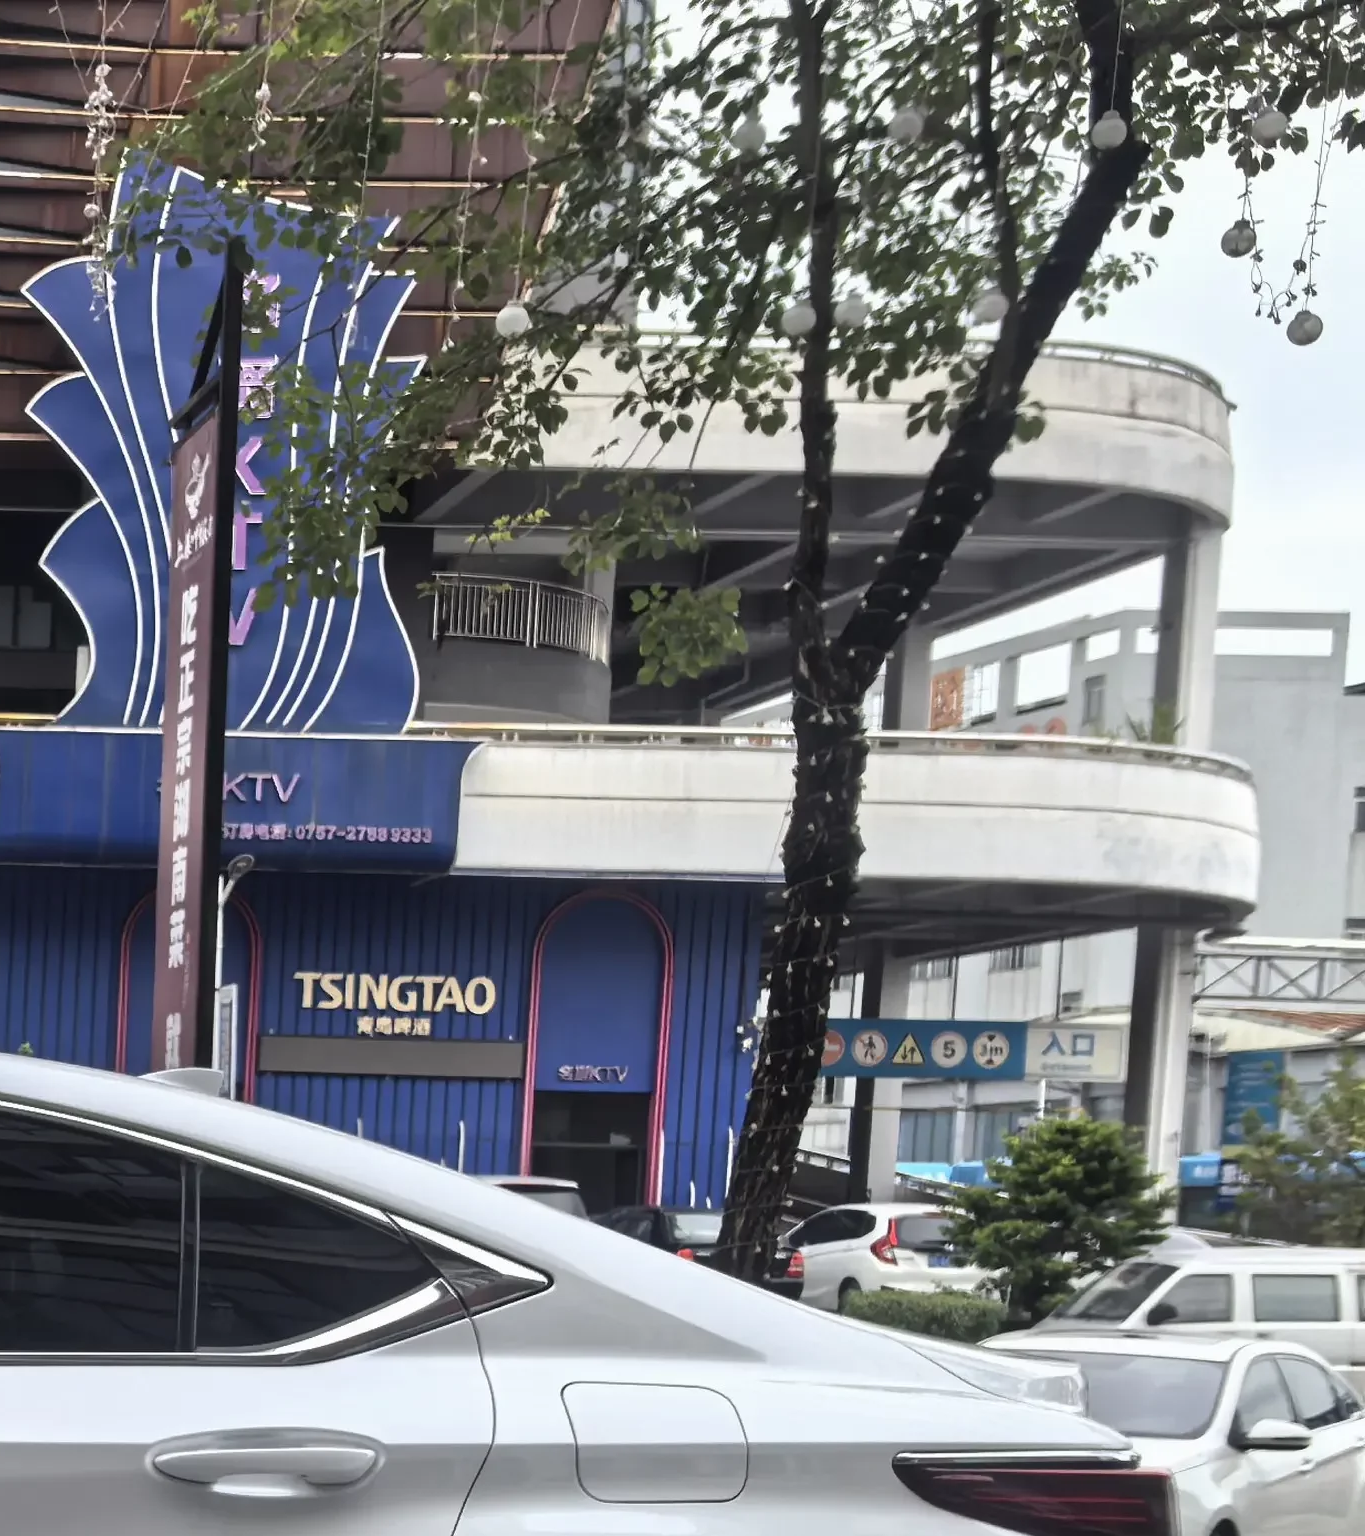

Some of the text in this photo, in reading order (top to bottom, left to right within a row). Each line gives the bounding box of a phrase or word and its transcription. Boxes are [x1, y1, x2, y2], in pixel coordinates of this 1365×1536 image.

[293, 971, 497, 1015] TSINGTAO
[941, 1040, 957, 1060] 5
[1041, 1031, 1095, 1057] 入口
